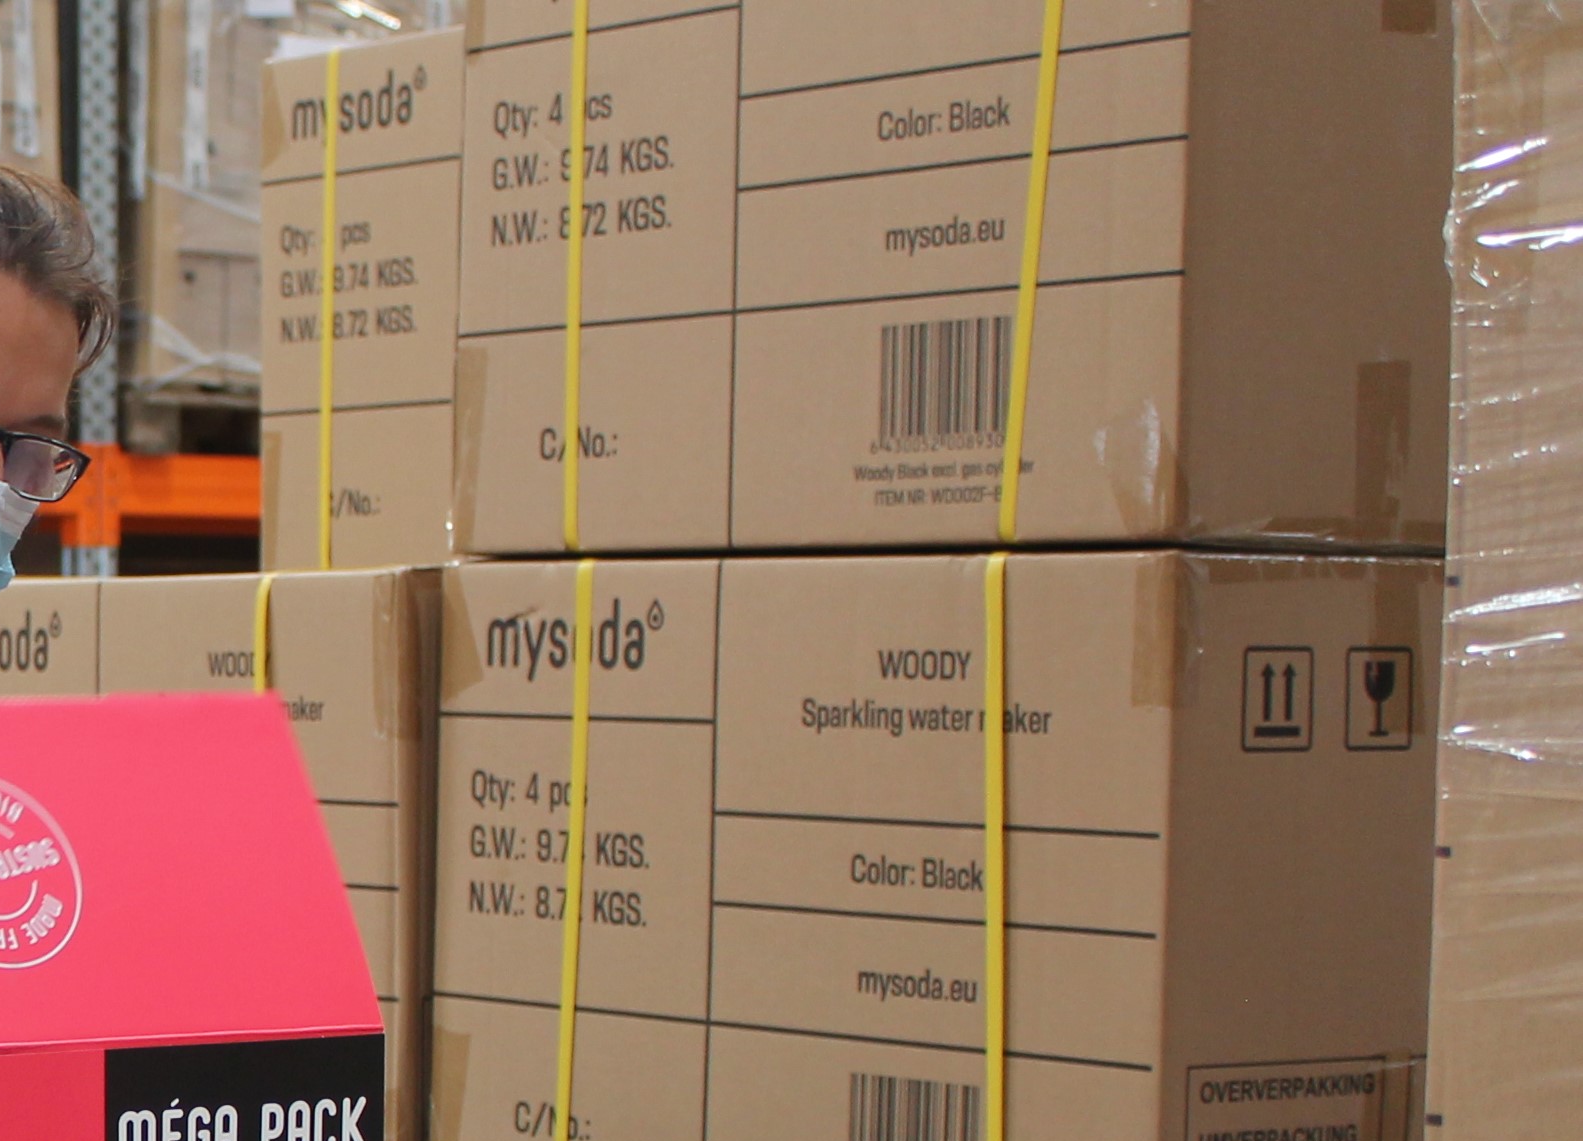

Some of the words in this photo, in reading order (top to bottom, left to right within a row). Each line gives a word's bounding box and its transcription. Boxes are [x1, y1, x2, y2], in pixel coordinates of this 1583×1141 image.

[494, 101, 538, 140] Qty:
[548, 92, 563, 125] 4
[582, 93, 612, 124] cs
[877, 105, 942, 143] Color:
[948, 96, 1011, 135] Black
[492, 153, 549, 191] G.W.:
[560, 142, 610, 183] 974
[620, 135, 675, 175] KGS.
[340, 222, 371, 253] pcs
[491, 209, 549, 247] N.W.:
[559, 202, 607, 240] 872
[617, 194, 672, 234] KGS.
[885, 212, 1006, 257] mysoda.eu
[376, 257, 418, 287] KGS.
[375, 304, 418, 334] KGS.
[487, 598, 645, 682] mysda
[879, 650, 971, 681] WOODY
[802, 698, 902, 737] Sparkling
[909, 704, 972, 732] water
[471, 769, 516, 810] Qty:
[526, 772, 539, 805] 4
[470, 824, 526, 860] G.W.:
[537, 829, 585, 863] 9.7
[596, 832, 650, 869] KGS.
[851, 853, 915, 886] Color:
[922, 857, 984, 891] Black
[469, 880, 525, 917] N.W.:
[535, 886, 582, 921] 8.7
[593, 889, 647, 927] KGS.
[858, 969, 978, 1004] mysoda.eu
[1200, 1073, 1376, 1104] OVERVERPAKKING
